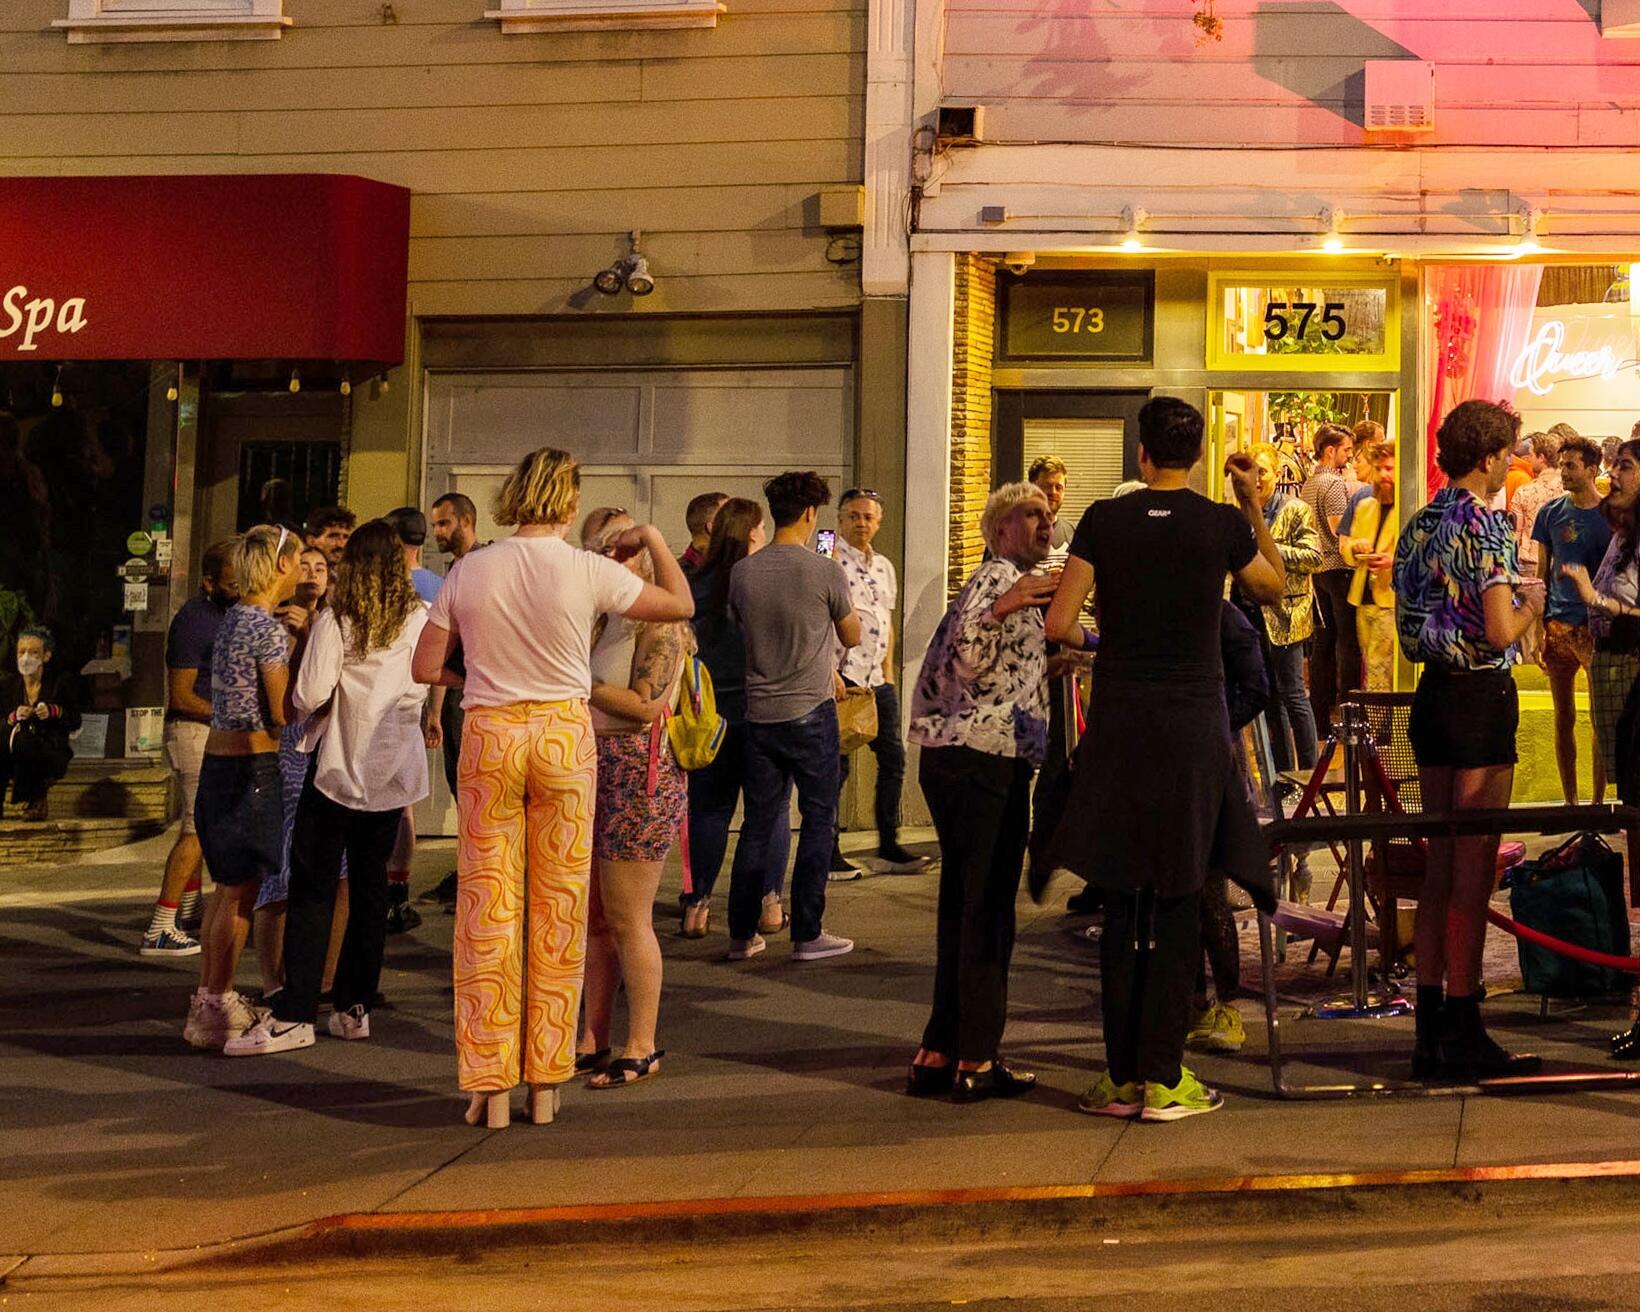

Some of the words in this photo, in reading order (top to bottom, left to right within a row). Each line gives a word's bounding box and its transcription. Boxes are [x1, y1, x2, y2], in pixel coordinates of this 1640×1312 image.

[0, 285, 88, 351] Spa
[1052, 307, 1104, 333] 573
[1263, 302, 1347, 340] 575
[1510, 320, 1624, 396] Queer
[131, 709, 149, 718] STOP
[151, 708, 163, 717] THE
